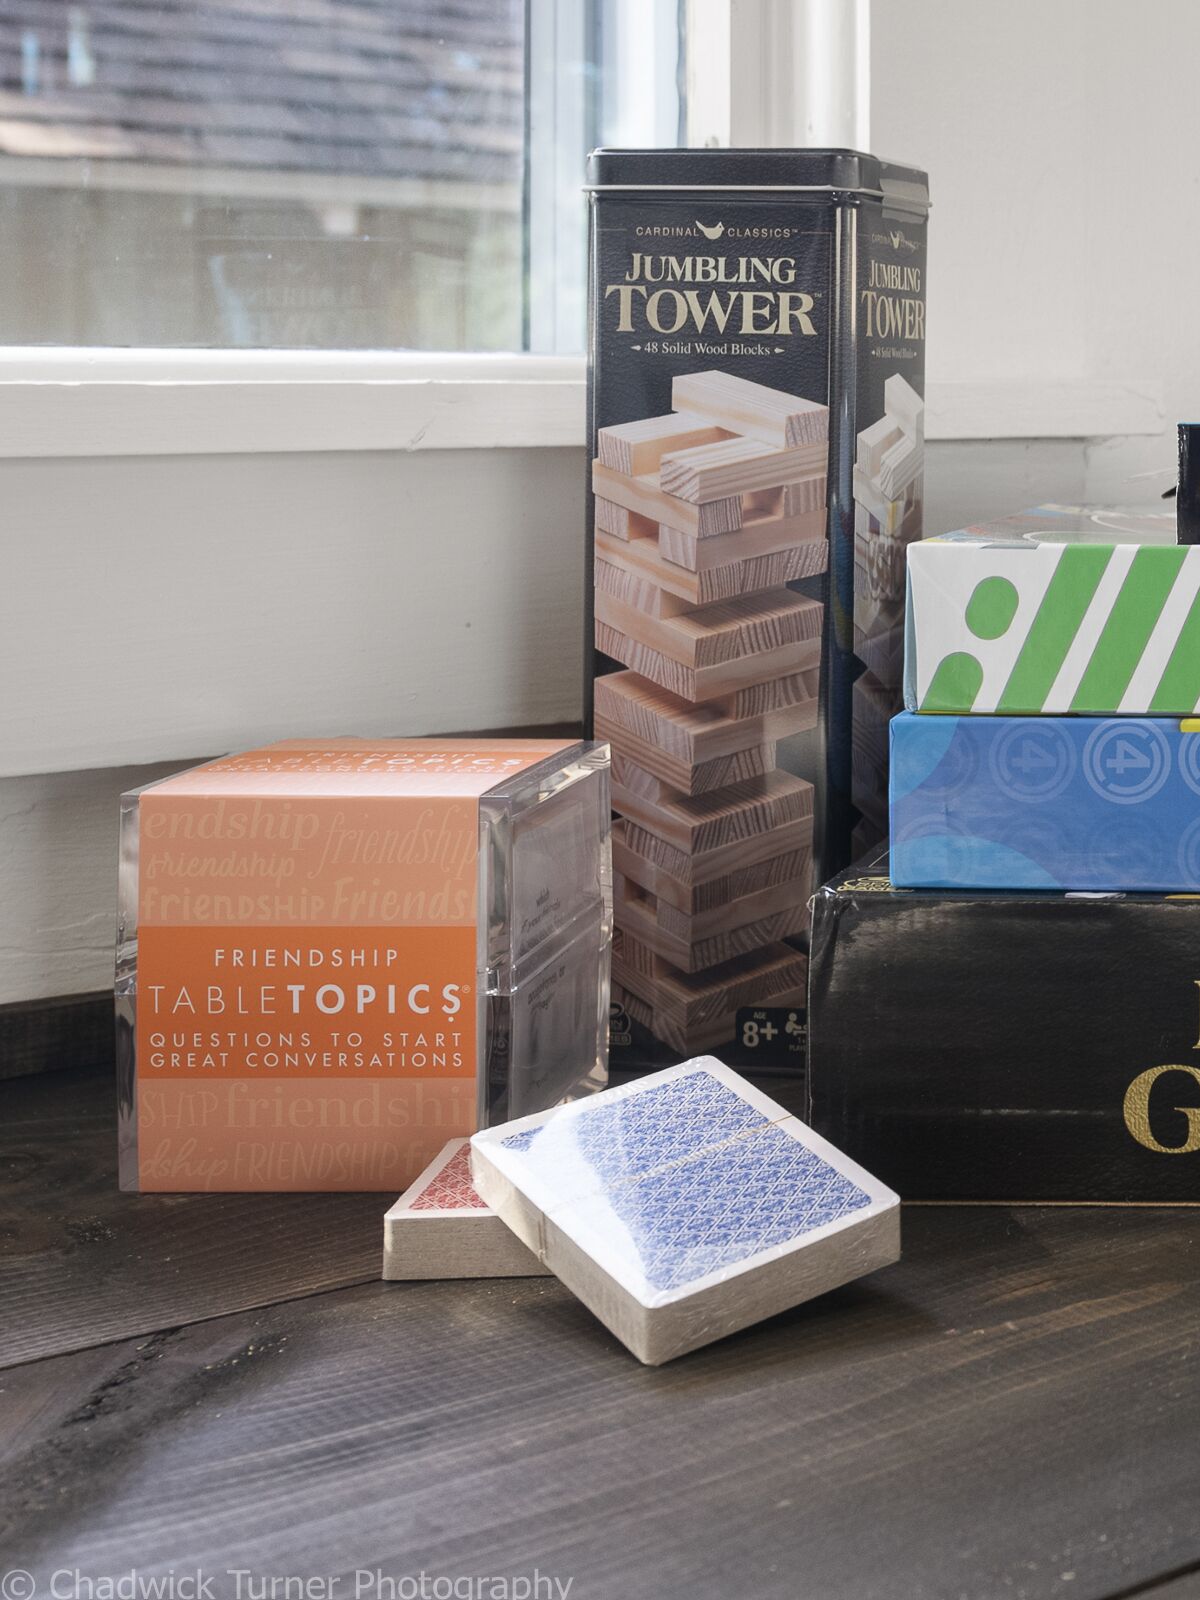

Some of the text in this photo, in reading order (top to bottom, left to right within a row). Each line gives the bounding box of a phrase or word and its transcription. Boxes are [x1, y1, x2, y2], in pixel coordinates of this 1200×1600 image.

[636, 226, 700, 237] CARDINAL
[625, 252, 797, 284] JUMBLING
[869, 260, 921, 293] JUMBLING
[862, 290, 925, 340] TOWER
[644, 342, 771, 356] 48 Solid Wood Blocks
[215, 949, 398, 967] FRIENDSHIP
[150, 1033, 461, 1048] QUESTIONS TO START
[743, 1021, 778, 1047] 8+
[150, 1053, 462, 1068] GREAT CONVERSATIONS
